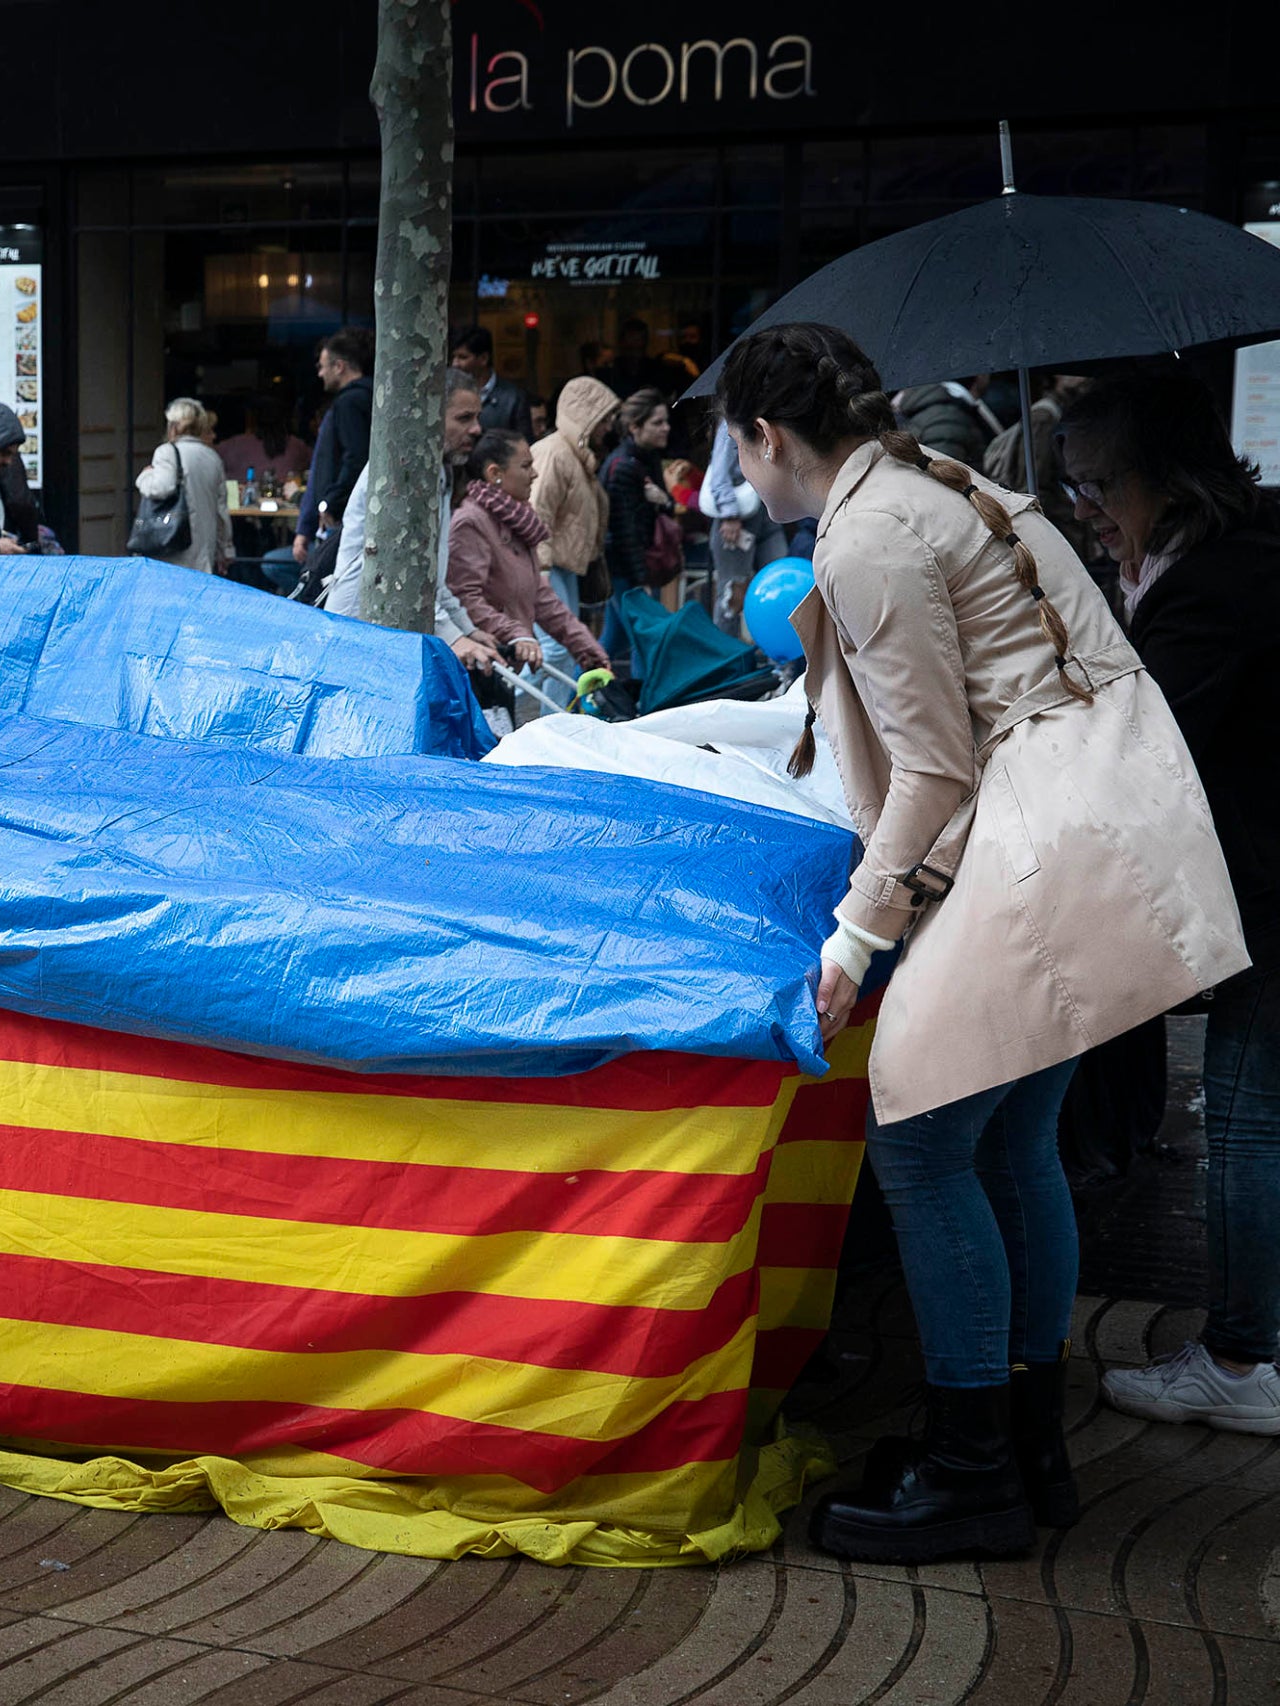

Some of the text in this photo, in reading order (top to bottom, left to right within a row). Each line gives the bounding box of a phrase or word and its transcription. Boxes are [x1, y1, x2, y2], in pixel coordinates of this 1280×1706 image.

[470, 33, 817, 127] la poma
[531, 255, 580, 279] WE'VE
[583, 252, 619, 279] GOT
[634, 254, 662, 280] ALL
